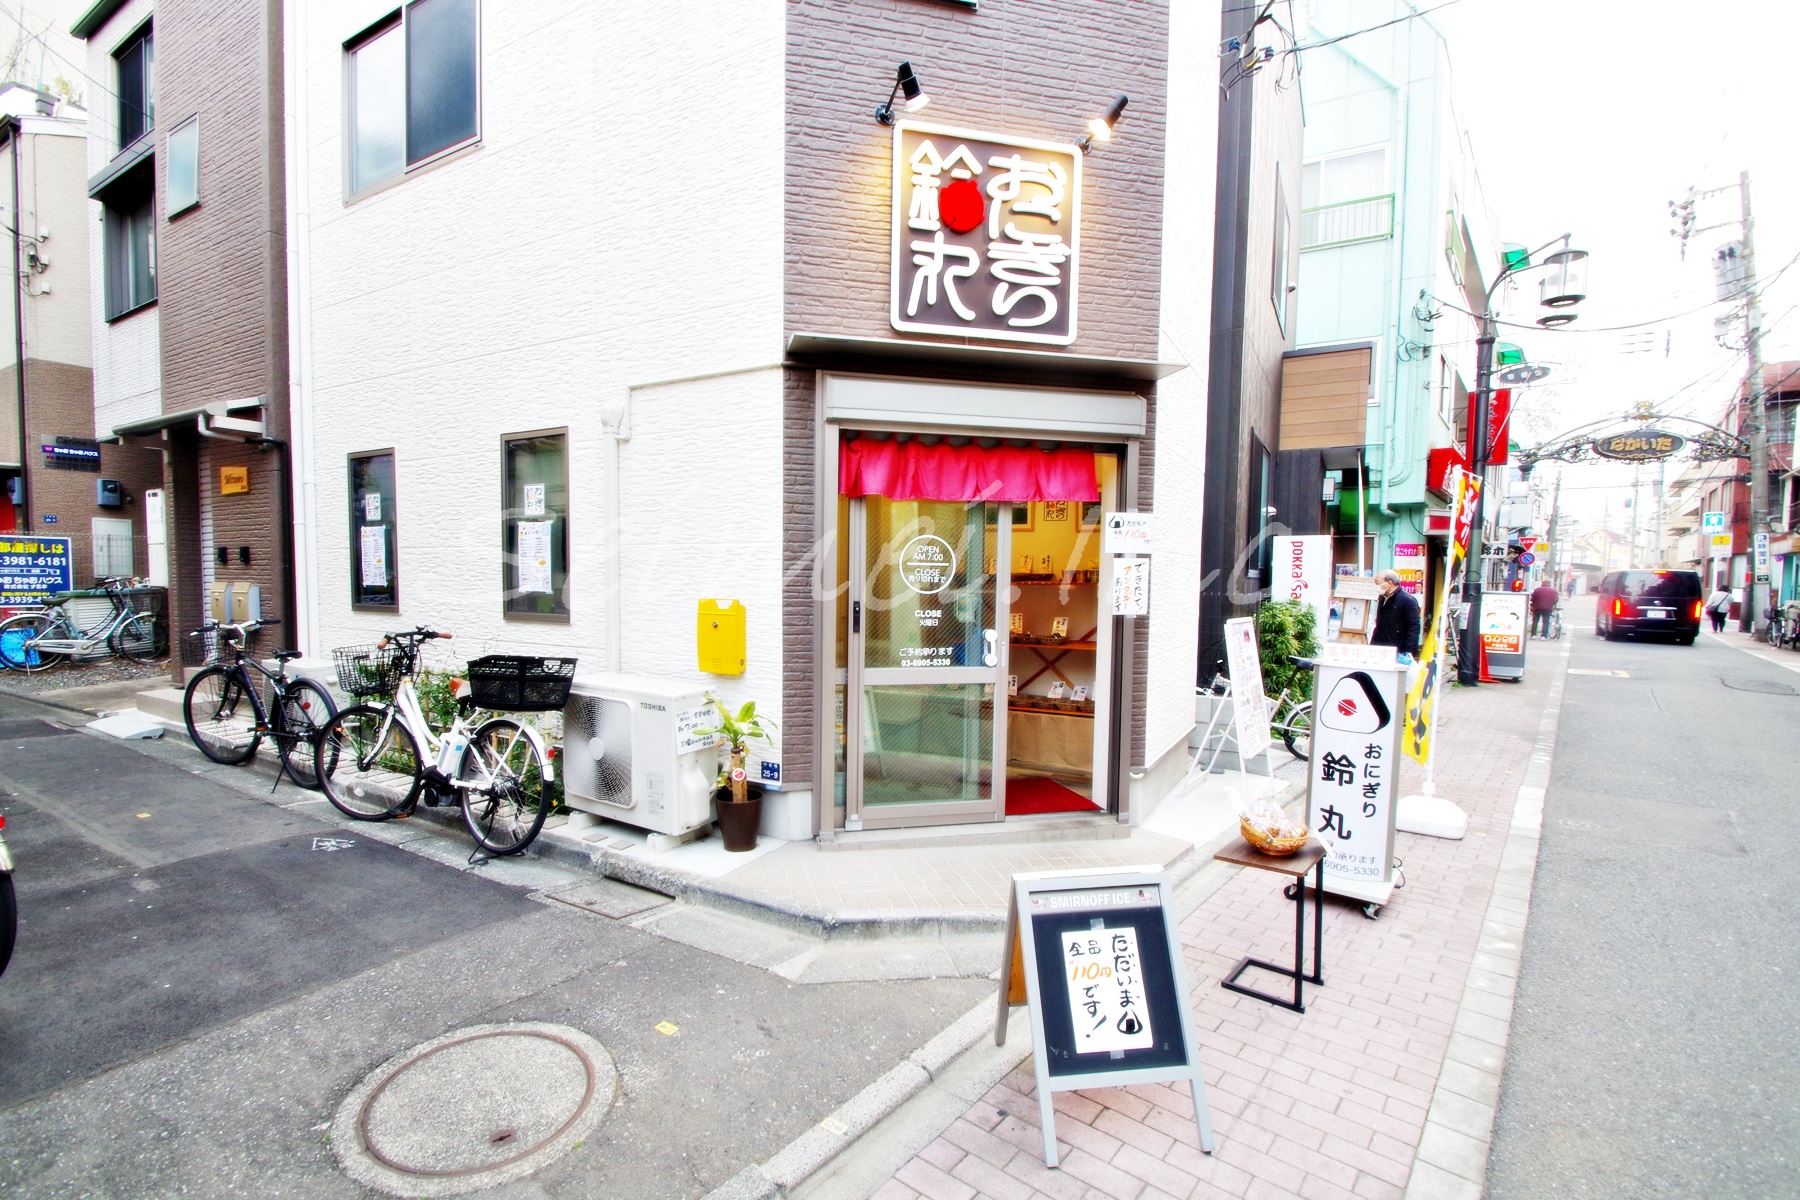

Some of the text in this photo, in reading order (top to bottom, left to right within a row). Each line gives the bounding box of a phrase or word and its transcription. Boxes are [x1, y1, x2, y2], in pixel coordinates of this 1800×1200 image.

[56, 436, 87, 446] Carino
[1610, 436, 1673, 452] なかいた
[917, 545, 940, 553] OPEN
[912, 553, 944, 561] AM 7:00
[914, 568, 941, 577] CLOSE
[908, 575, 946, 583] 売り切れまで
[914, 609, 942, 618] CLOSE
[918, 619, 939, 627] 火曜日
[899, 646, 954, 657] ご予約承ります
[1328, 645, 1391, 660] 営業中です
[901, 658, 951, 668] 03-6905-5330
[640, 702, 666, 711] TOSHIBA
[763, 769, 778, 779] 25-9
[1362, 743, 1383, 818] おにぎり
[1318, 751, 1356, 840] 鈴丸
[1050, 892, 1131, 909] SMIRNOFF ICE
[1068, 940, 1102, 957] 全品
[1072, 962, 1112, 982] 110円
[1111, 933, 1136, 1008] ただいま
